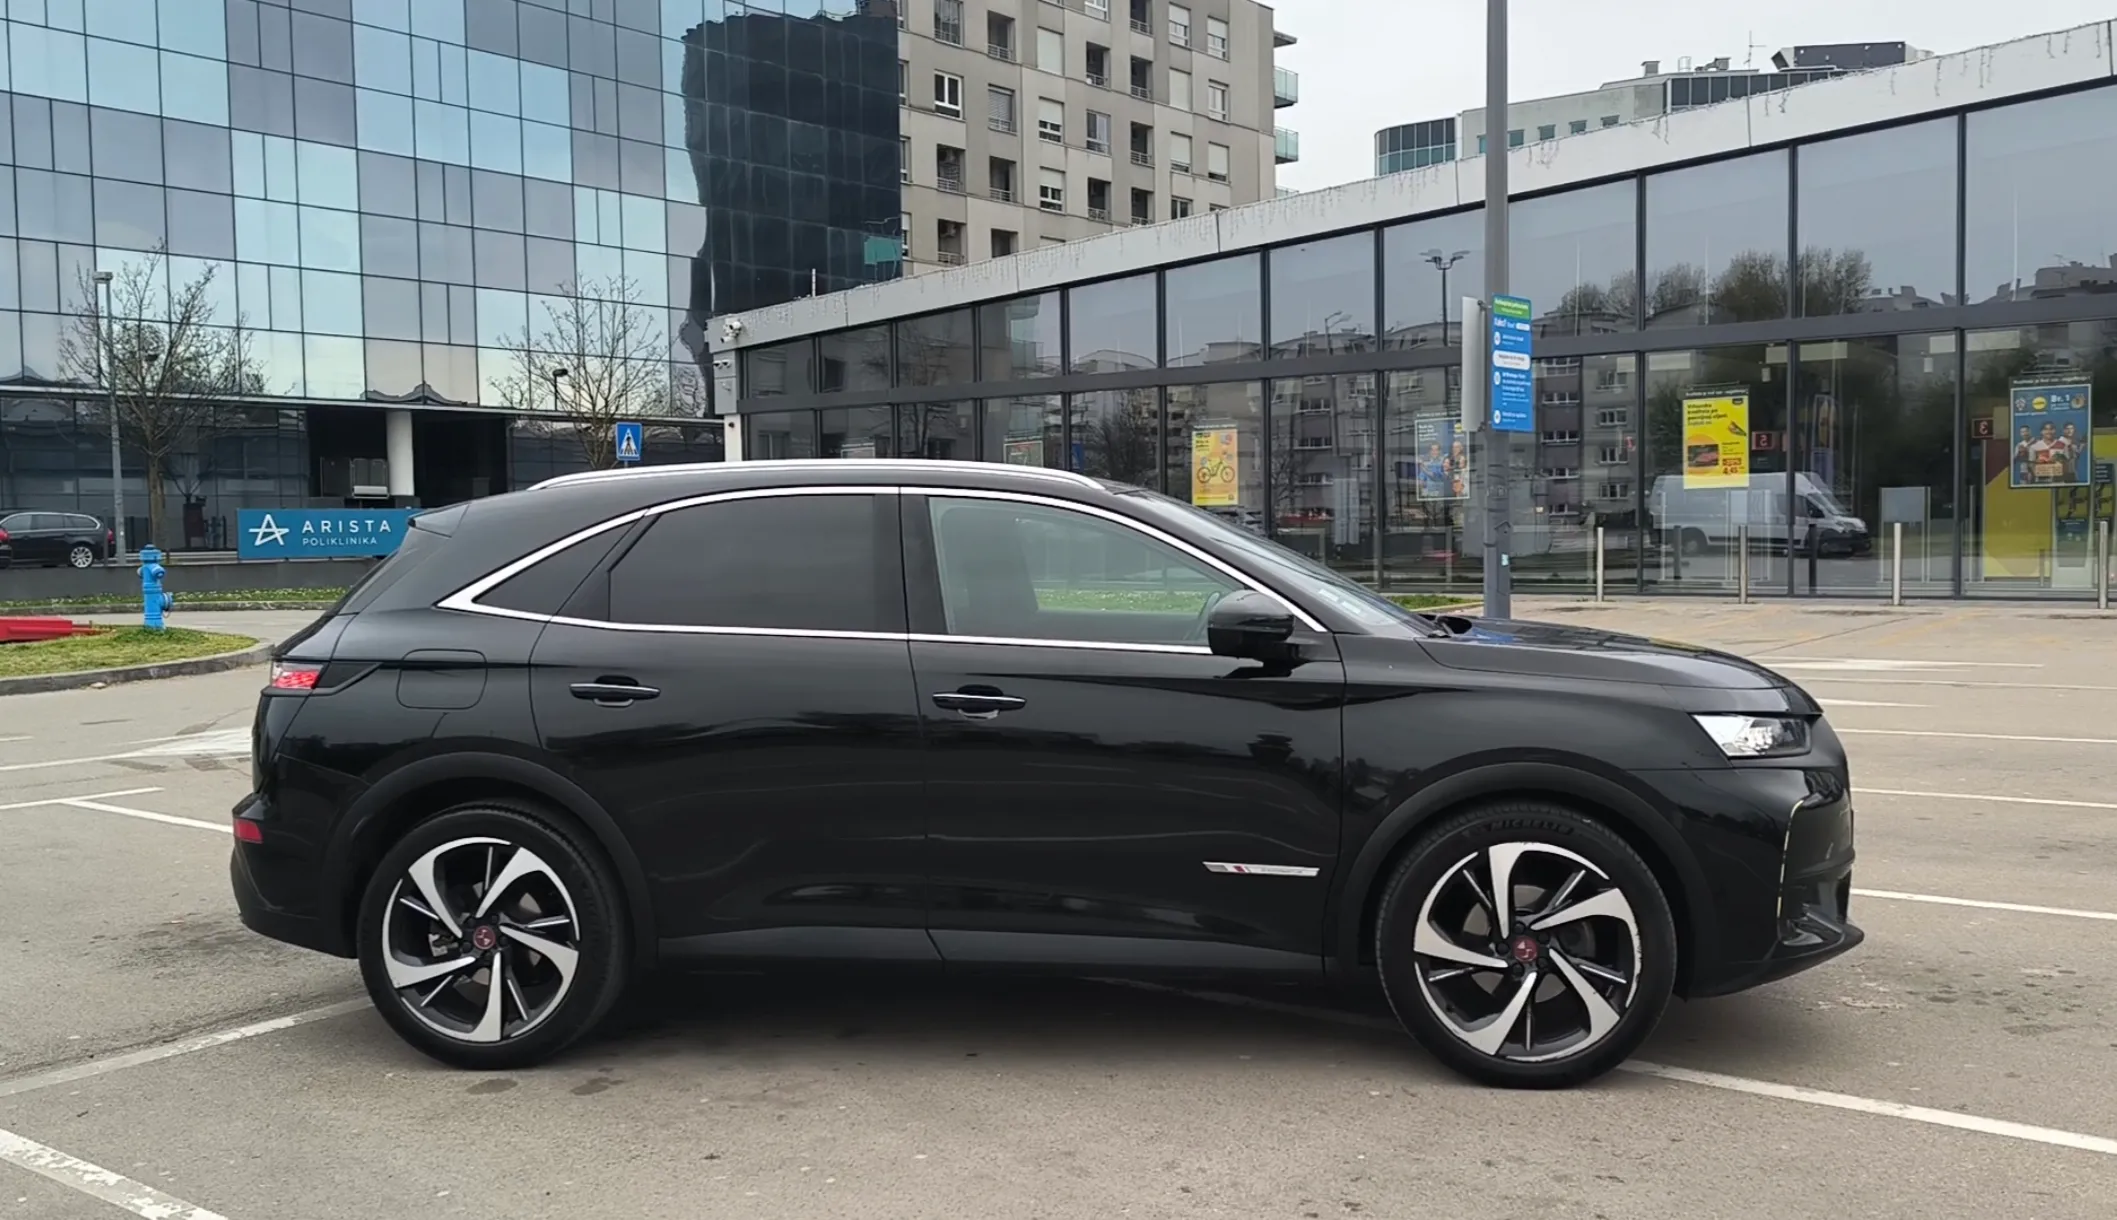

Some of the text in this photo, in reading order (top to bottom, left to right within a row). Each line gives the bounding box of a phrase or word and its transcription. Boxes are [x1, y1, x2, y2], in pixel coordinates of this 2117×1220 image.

[302, 520, 391, 533] ARISTA
[302, 537, 378, 546] POLIKLINIKA
[1491, 818, 1574, 835] MICHELIN
